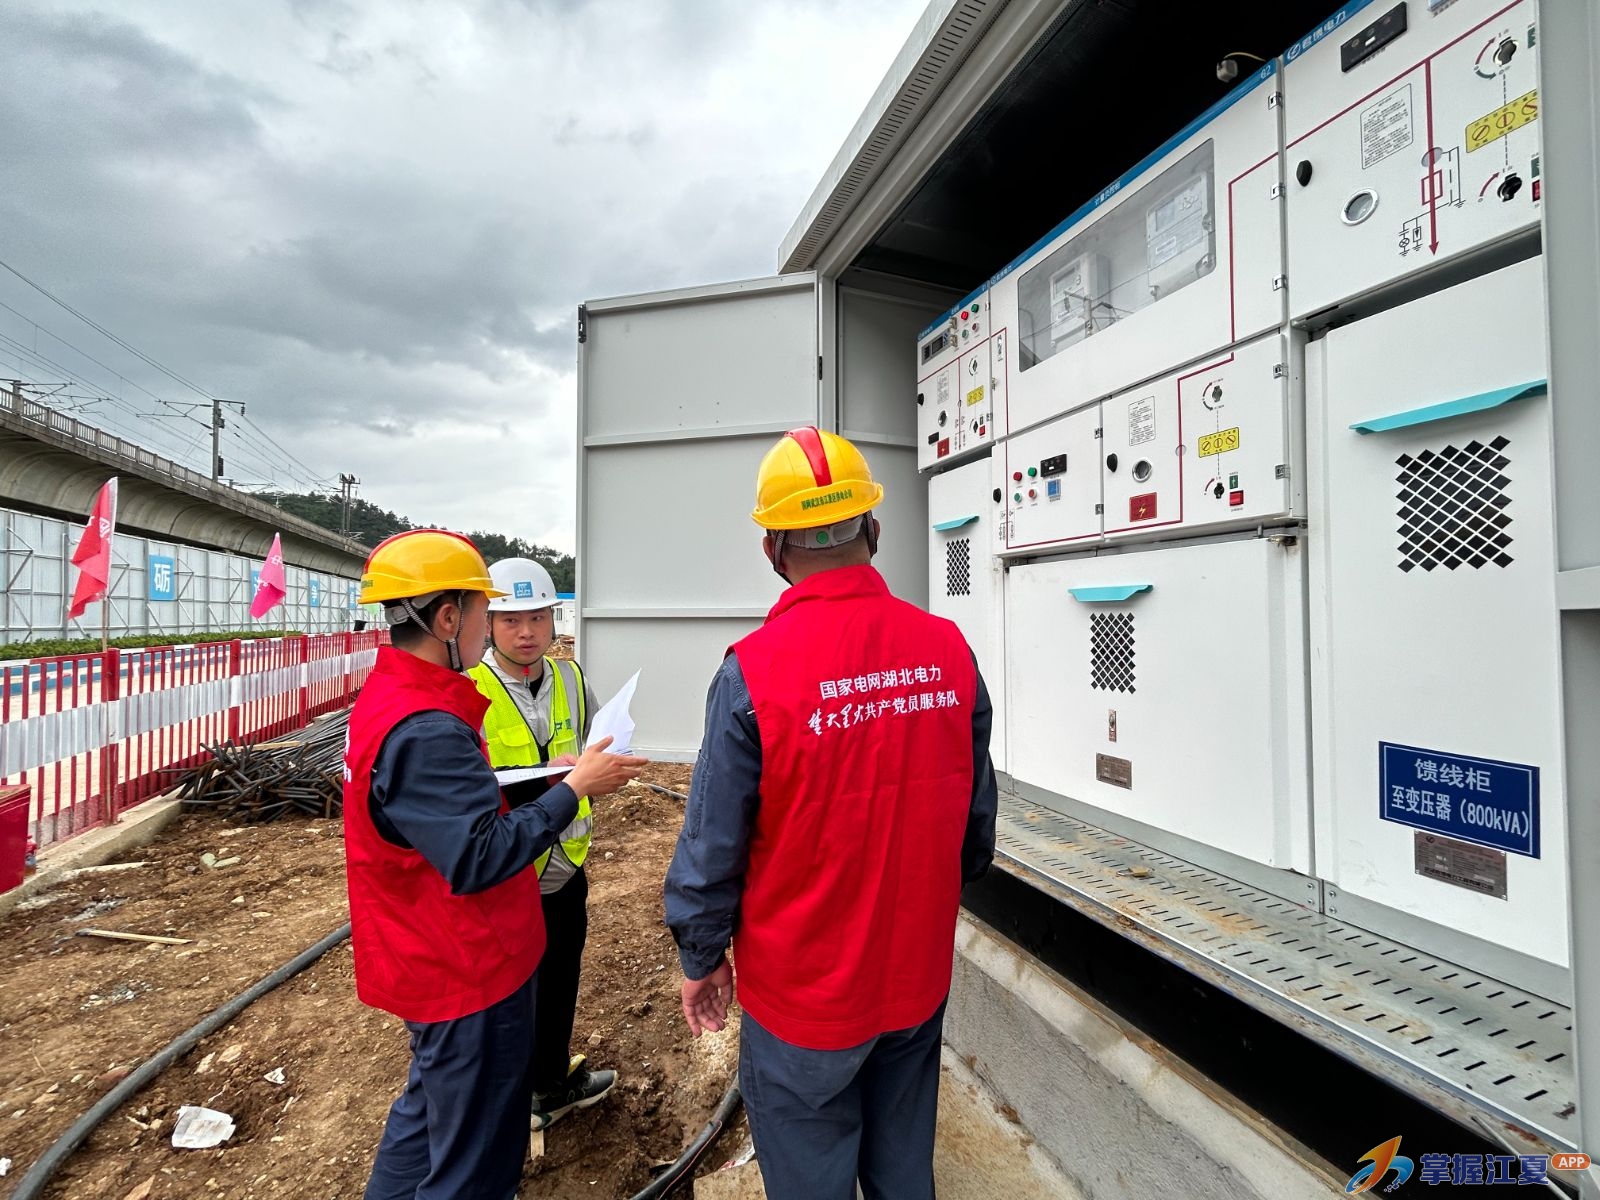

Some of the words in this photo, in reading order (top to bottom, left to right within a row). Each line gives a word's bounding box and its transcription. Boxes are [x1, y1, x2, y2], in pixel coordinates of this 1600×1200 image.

[154, 563, 171, 593] 砺
[819, 664, 941, 700] 国家电网湖北电力
[1414, 758, 1492, 793] 馈线柜
